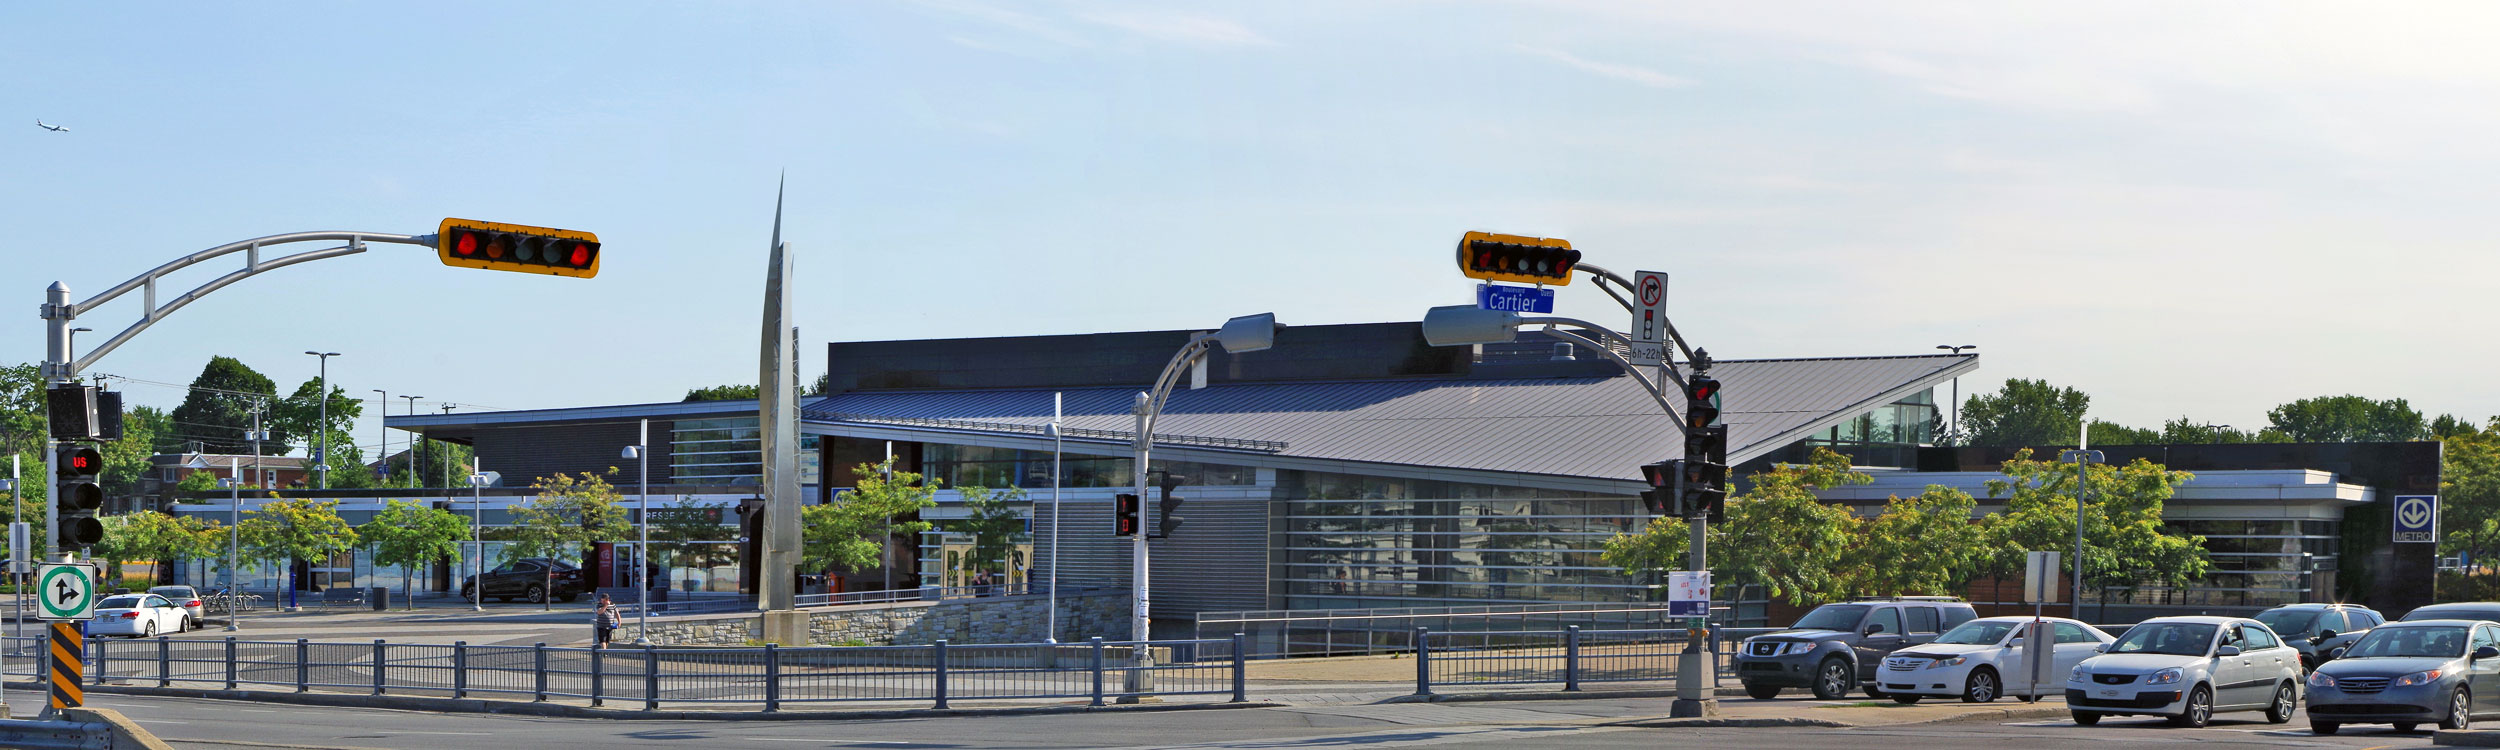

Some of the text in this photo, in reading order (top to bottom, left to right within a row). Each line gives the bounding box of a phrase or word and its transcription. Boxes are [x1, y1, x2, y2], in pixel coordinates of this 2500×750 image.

[1489, 292, 1537, 312] Cartier
[1632, 348, 1661, 360] 6h-22h
[646, 511, 675, 520] RESSE
[2395, 531, 2431, 541] METRO
